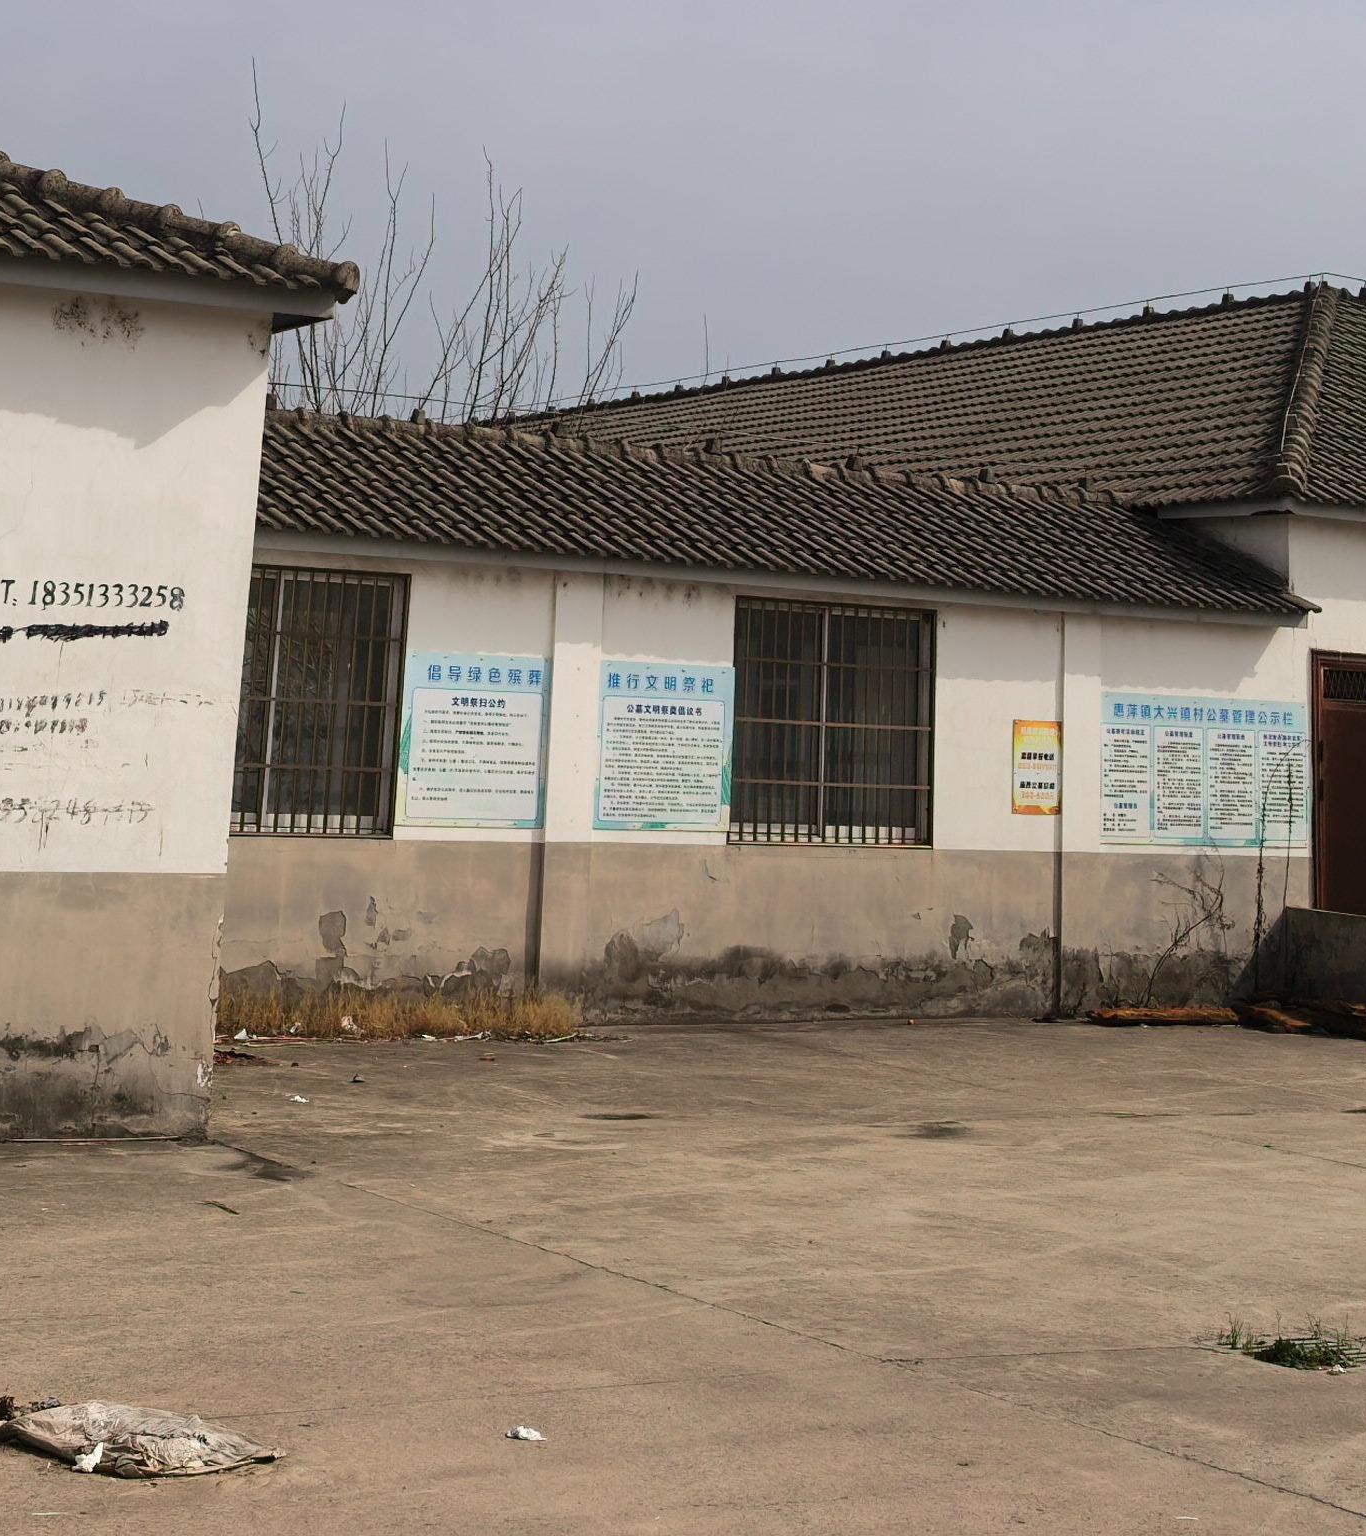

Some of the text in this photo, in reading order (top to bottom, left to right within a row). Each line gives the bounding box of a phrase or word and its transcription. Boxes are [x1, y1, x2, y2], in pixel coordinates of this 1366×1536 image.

[27, 580, 186, 611] 18351333258
[427, 664, 543, 686] 倡导绿色殡葬
[607, 672, 715, 693] 推行文明祭祀
[451, 696, 506, 709] 文明祭扫公约
